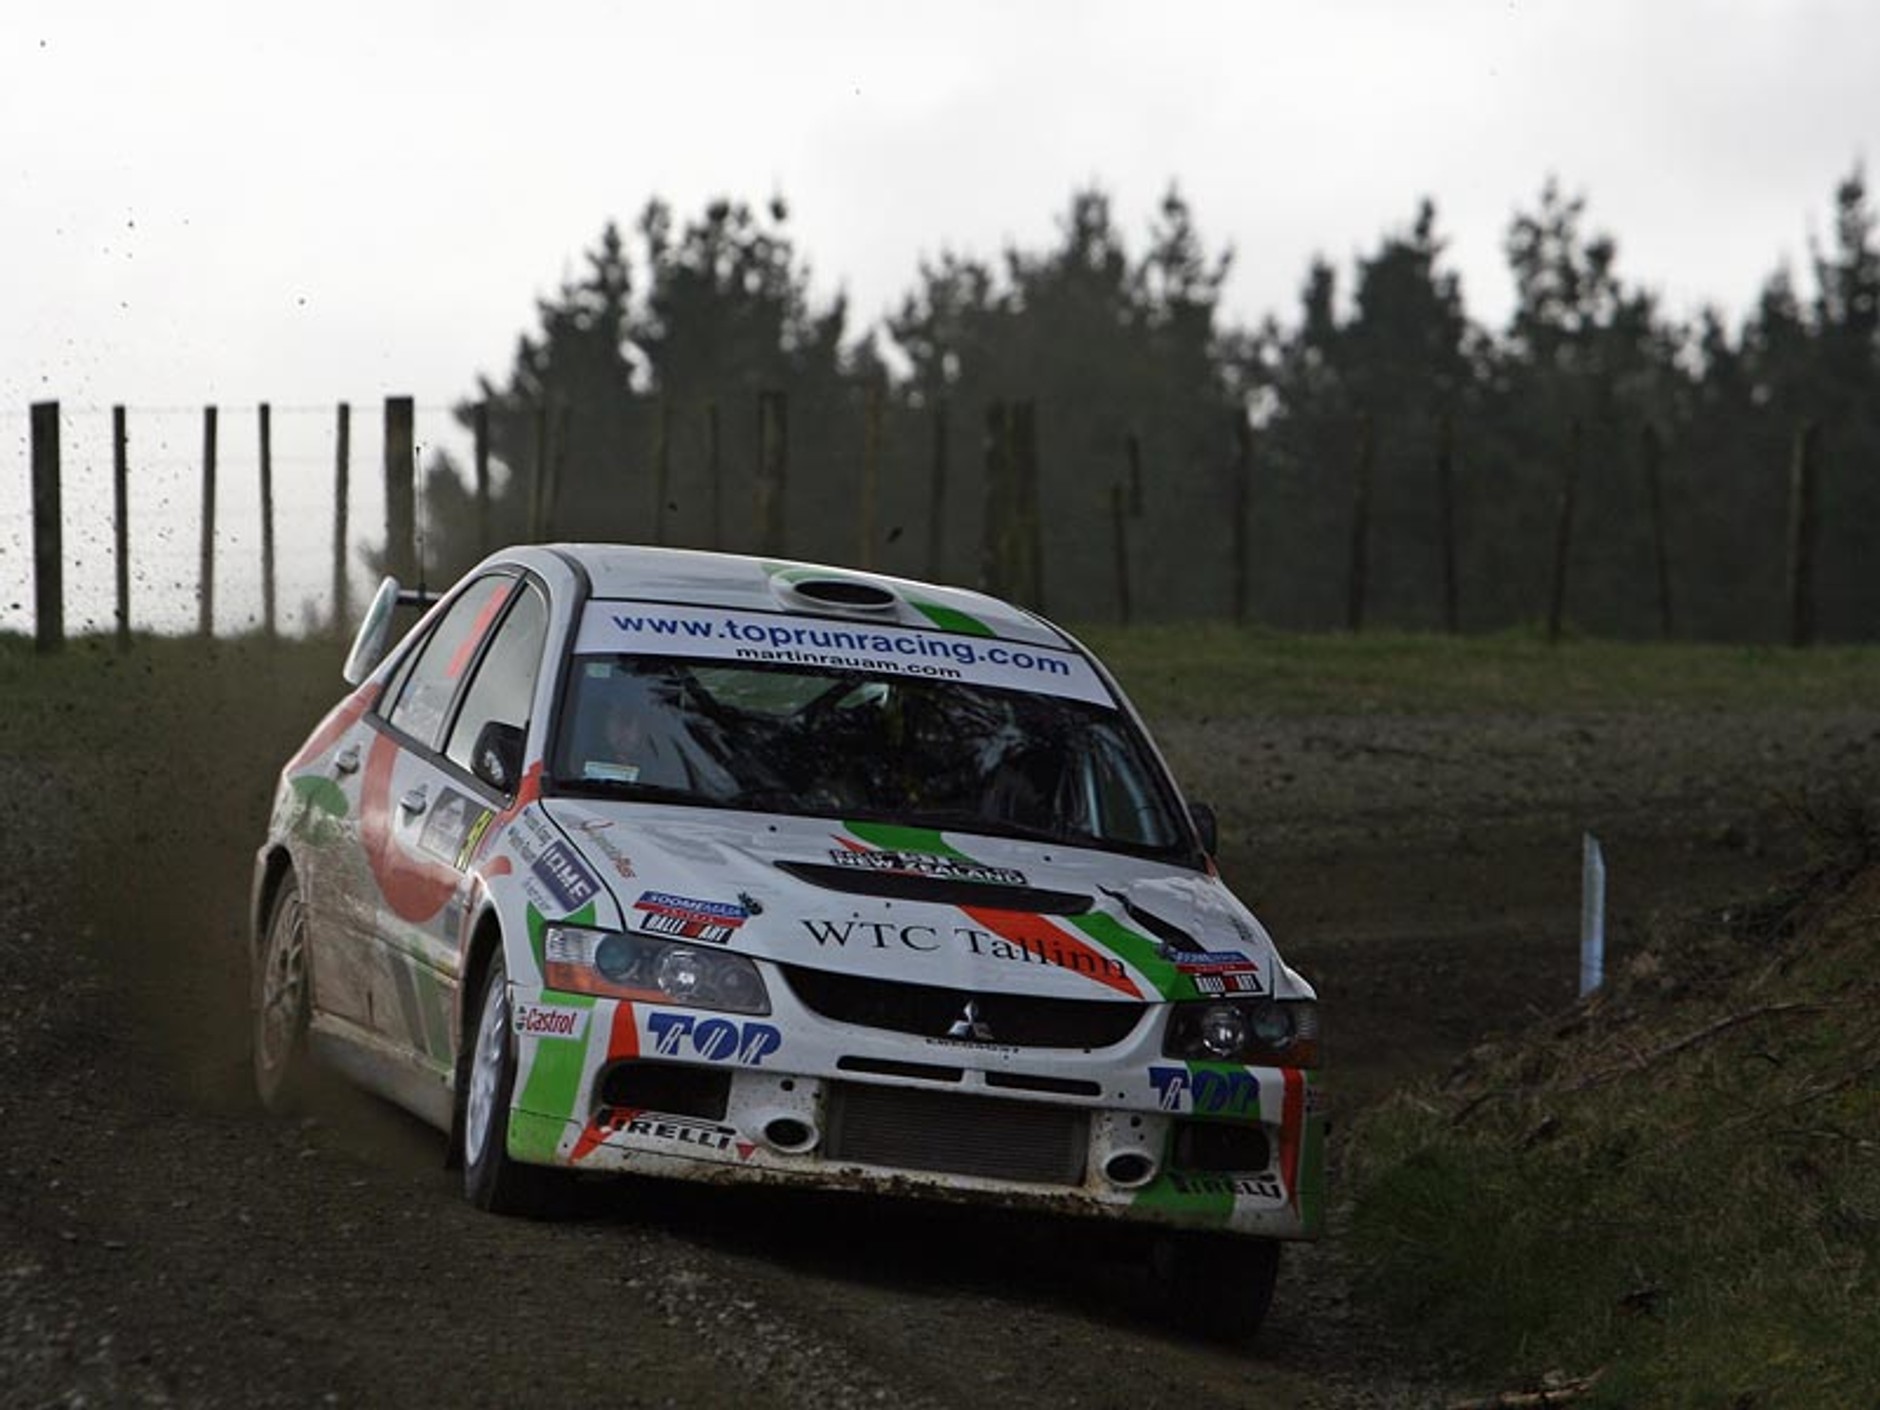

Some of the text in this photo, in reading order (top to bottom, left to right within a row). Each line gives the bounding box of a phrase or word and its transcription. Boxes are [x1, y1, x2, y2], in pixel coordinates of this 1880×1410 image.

[612, 614, 1070, 677] www.toprunracing.com
[735, 647, 961, 679] martinrauam.com
[801, 919, 1126, 980] WTC Tallinn
[526, 1007, 577, 1035] Castrol
[647, 1012, 782, 1066] TOP
[1148, 1066, 1261, 1114] TOP
